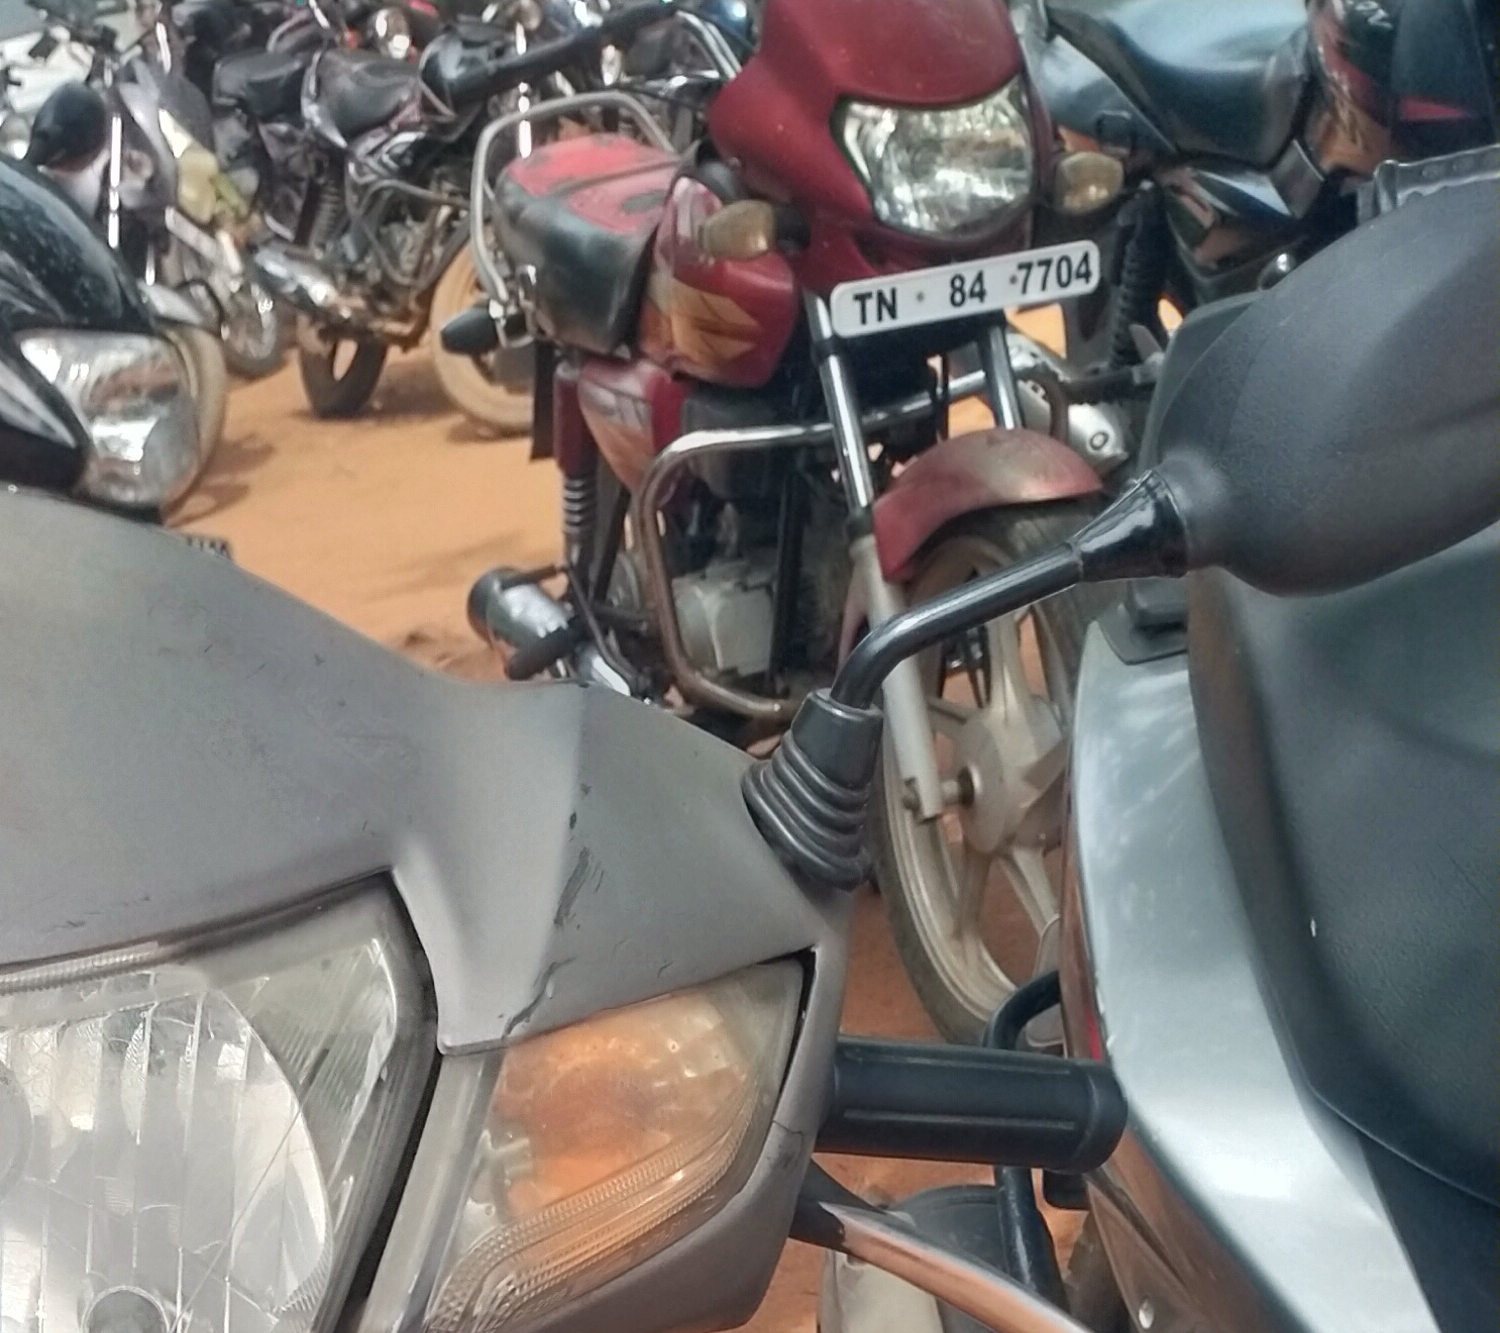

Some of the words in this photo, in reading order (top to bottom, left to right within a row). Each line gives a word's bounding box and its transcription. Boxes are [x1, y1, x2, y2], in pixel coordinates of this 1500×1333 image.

[852, 286, 898, 327] TN
[949, 269, 988, 308] 84
[1015, 250, 1093, 296] 7704
